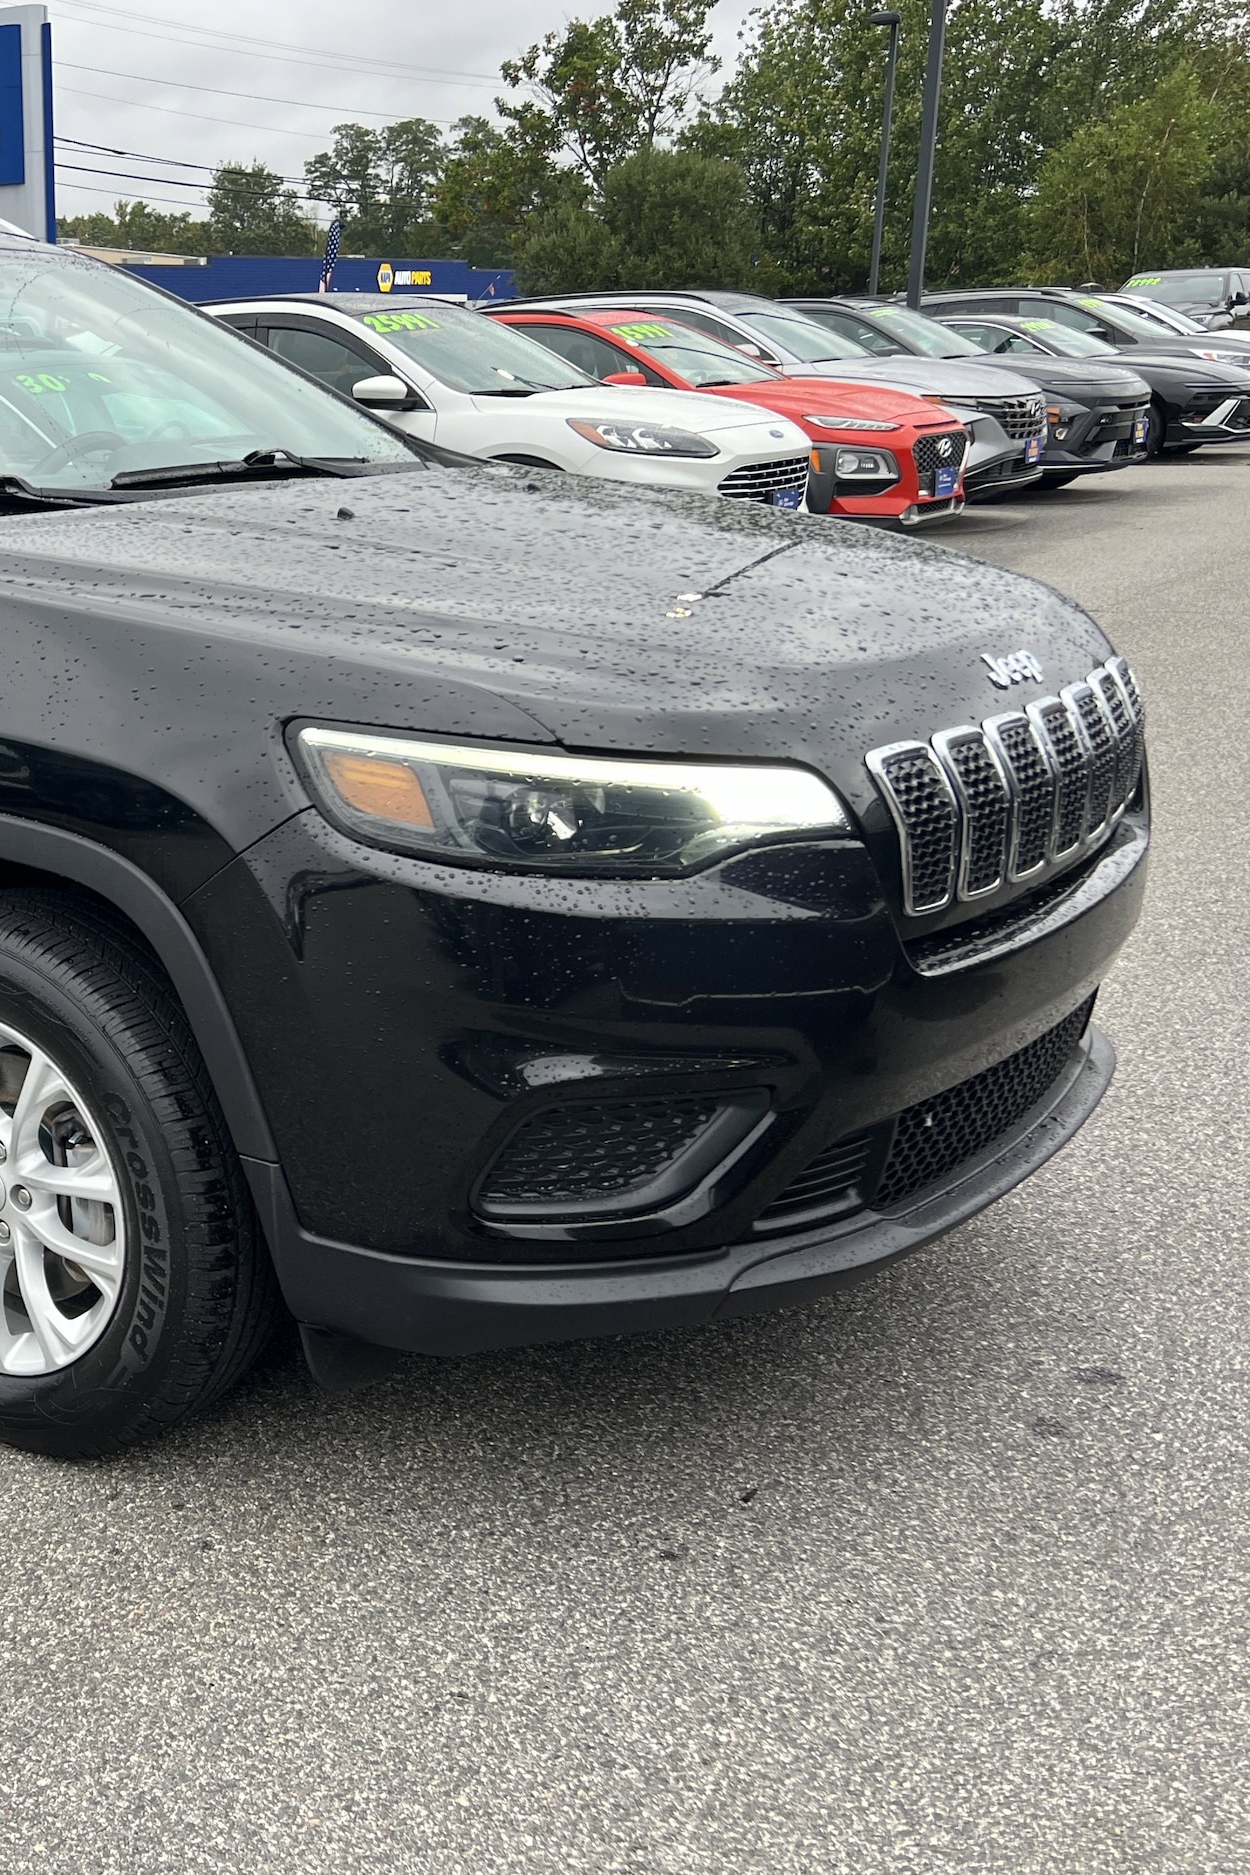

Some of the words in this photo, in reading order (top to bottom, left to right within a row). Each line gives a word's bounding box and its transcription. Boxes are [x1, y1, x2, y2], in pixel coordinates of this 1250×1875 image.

[394, 270, 411, 286] AUTO
[411, 270, 432, 286] PARTS
[363, 313, 441, 333] 25991
[979, 649, 1043, 688] Jeep
